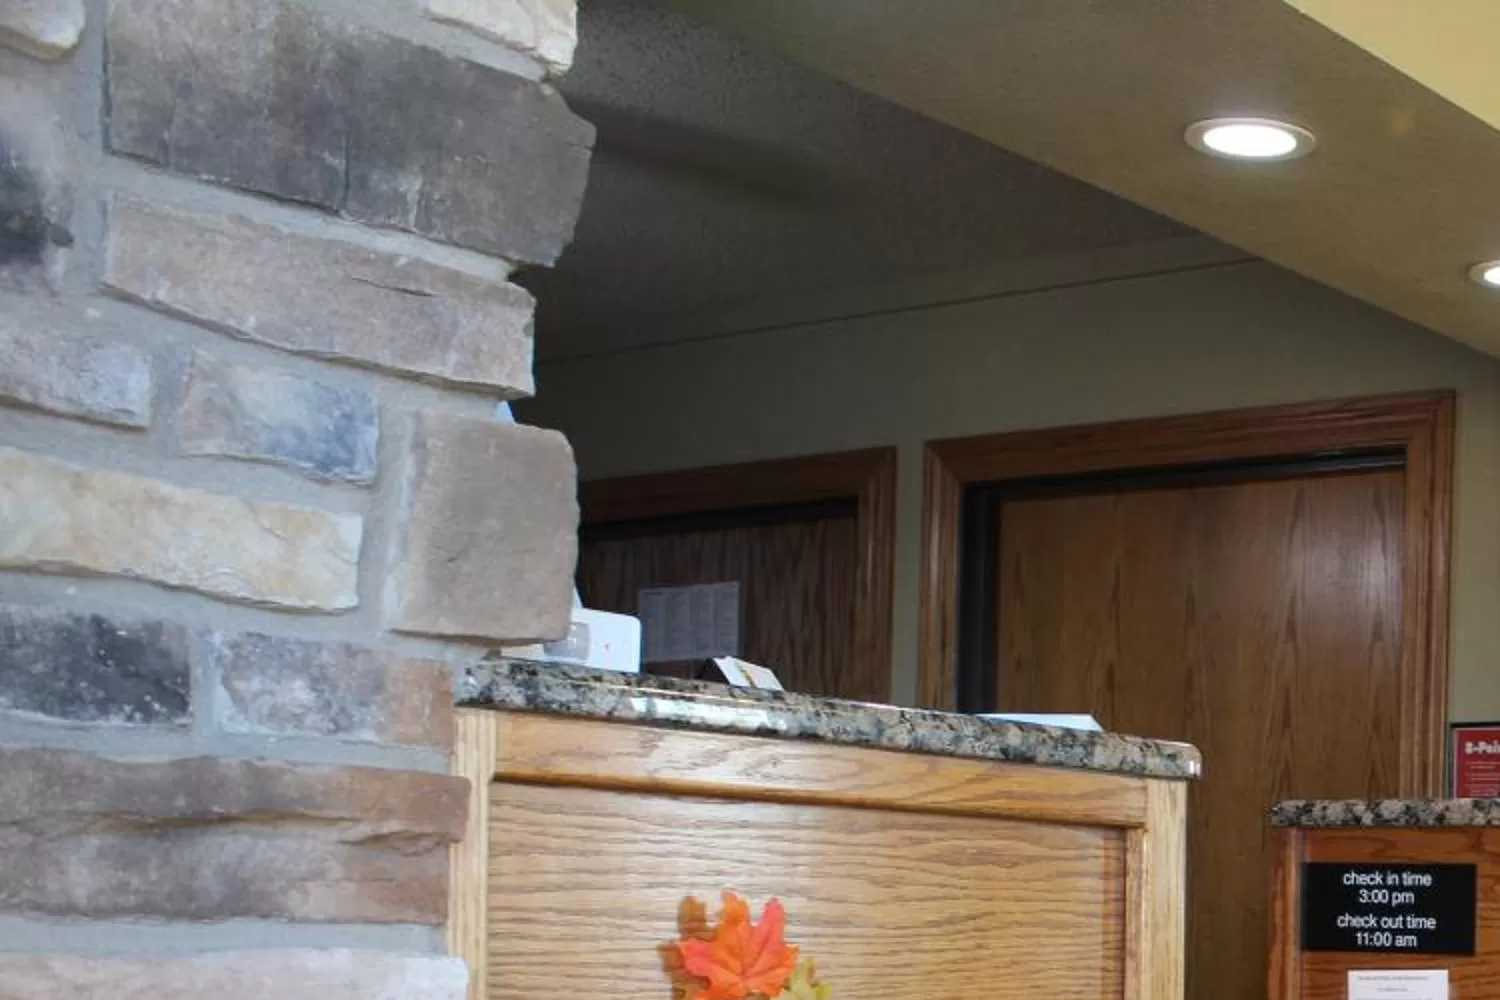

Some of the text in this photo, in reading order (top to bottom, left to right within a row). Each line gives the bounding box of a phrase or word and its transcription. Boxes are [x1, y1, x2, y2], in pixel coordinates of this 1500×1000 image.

[1343, 870, 1433, 888] check in time
[1358, 889, 1415, 907] 3:00 pm
[1336, 912, 1437, 930] check out time
[1356, 931, 1417, 947] 11:00 am
